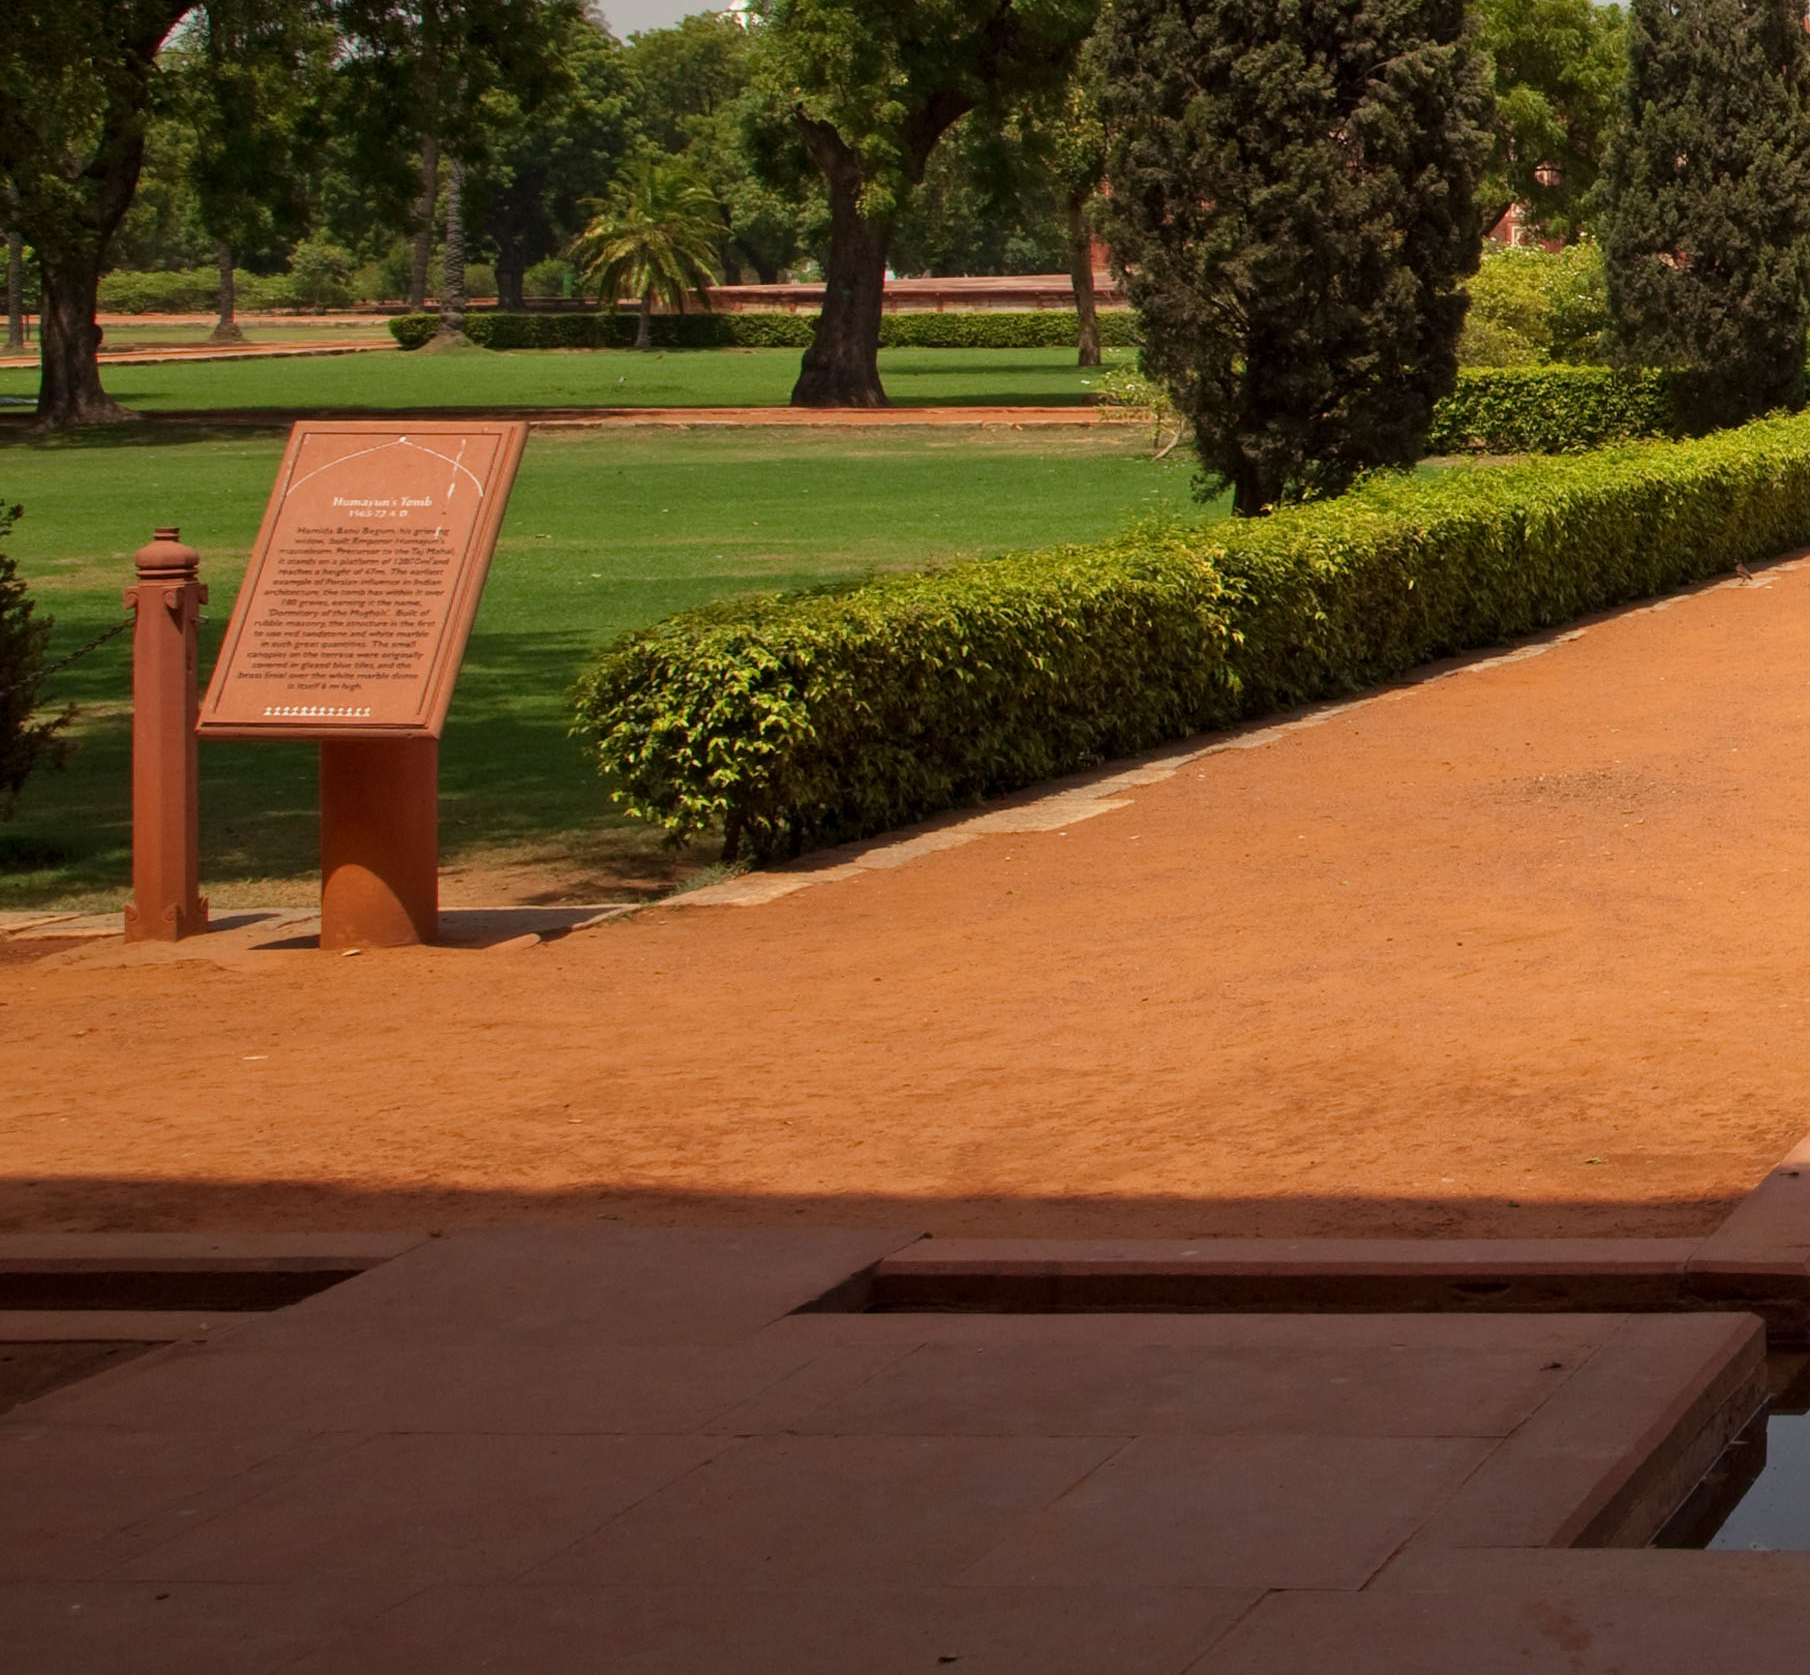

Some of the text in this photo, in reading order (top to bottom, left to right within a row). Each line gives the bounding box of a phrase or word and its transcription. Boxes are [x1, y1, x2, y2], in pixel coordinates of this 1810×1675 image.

[332, 496, 433, 508] Humayun's Tomb
[322, 568, 351, 577] height
